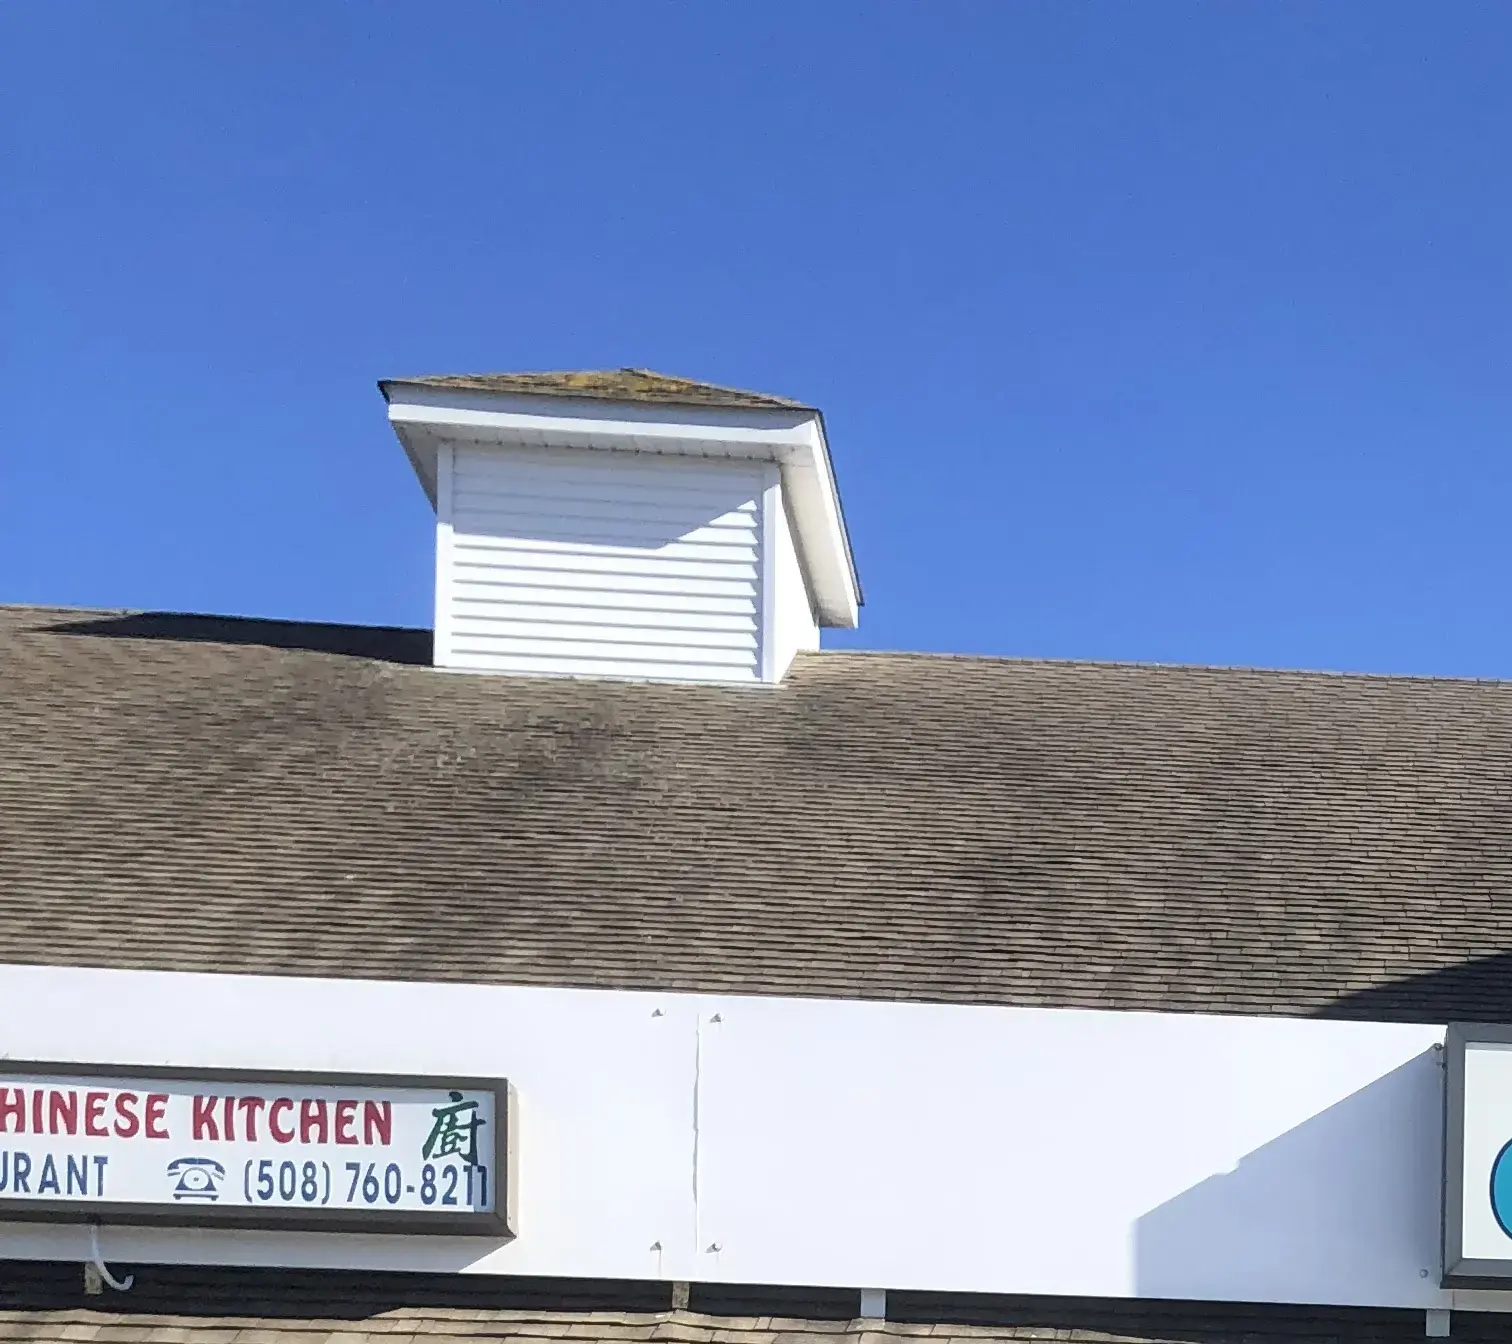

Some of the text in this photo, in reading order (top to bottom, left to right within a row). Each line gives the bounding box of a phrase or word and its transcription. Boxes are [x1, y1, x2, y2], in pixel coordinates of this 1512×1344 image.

[0, 1088, 392, 1146] HINESE KITCHEN
[244, 1159, 330, 1204] (508)
[345, 1162, 487, 1206] 760-8211
